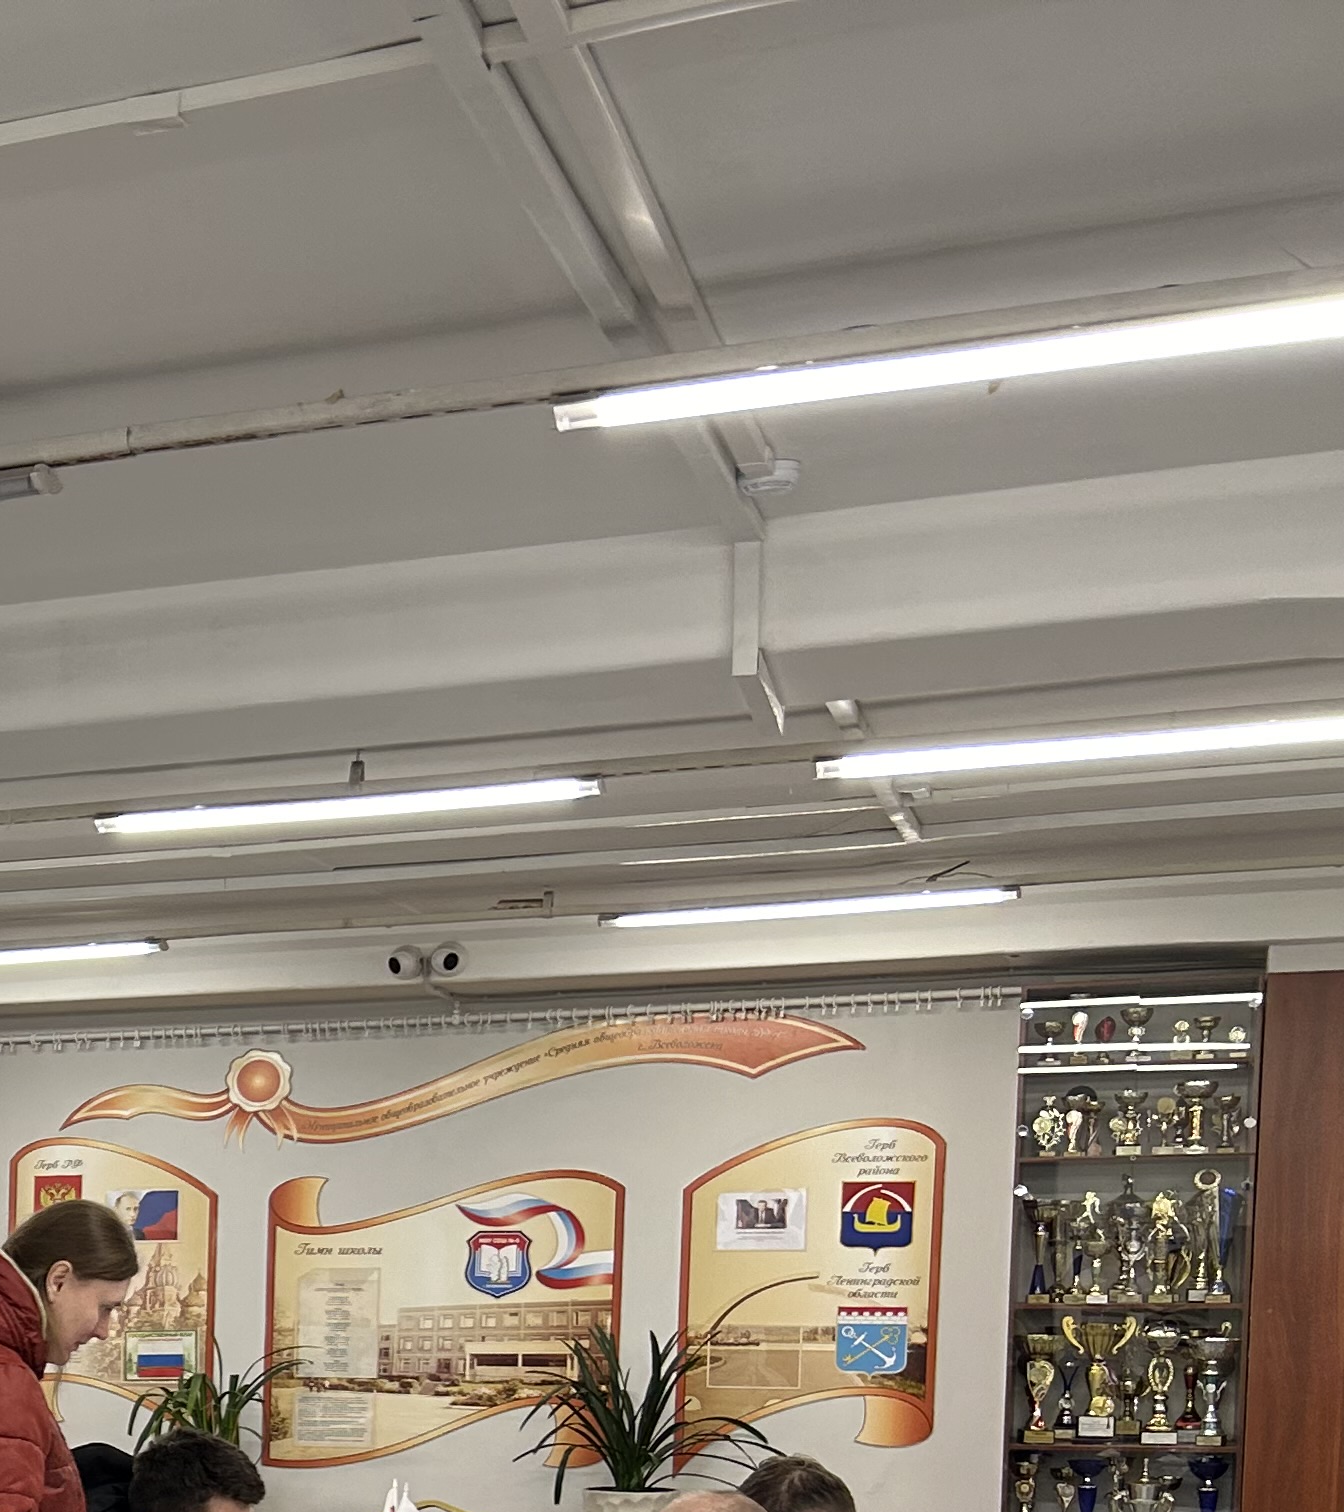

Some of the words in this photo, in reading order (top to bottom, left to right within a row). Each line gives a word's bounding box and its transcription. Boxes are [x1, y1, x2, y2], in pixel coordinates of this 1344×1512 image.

[864, 1139, 898, 1152] Герб
[34, 1159, 59, 1170] Герб
[831, 1153, 929, 1164] Всеволожского
[856, 1166, 900, 1178] района
[294, 1243, 333, 1256] Гимн
[337, 1246, 382, 1256] школы
[858, 1262, 891, 1274] Герб
[827, 1274, 921, 1287] Ленинградской
[847, 1287, 898, 1298] области
